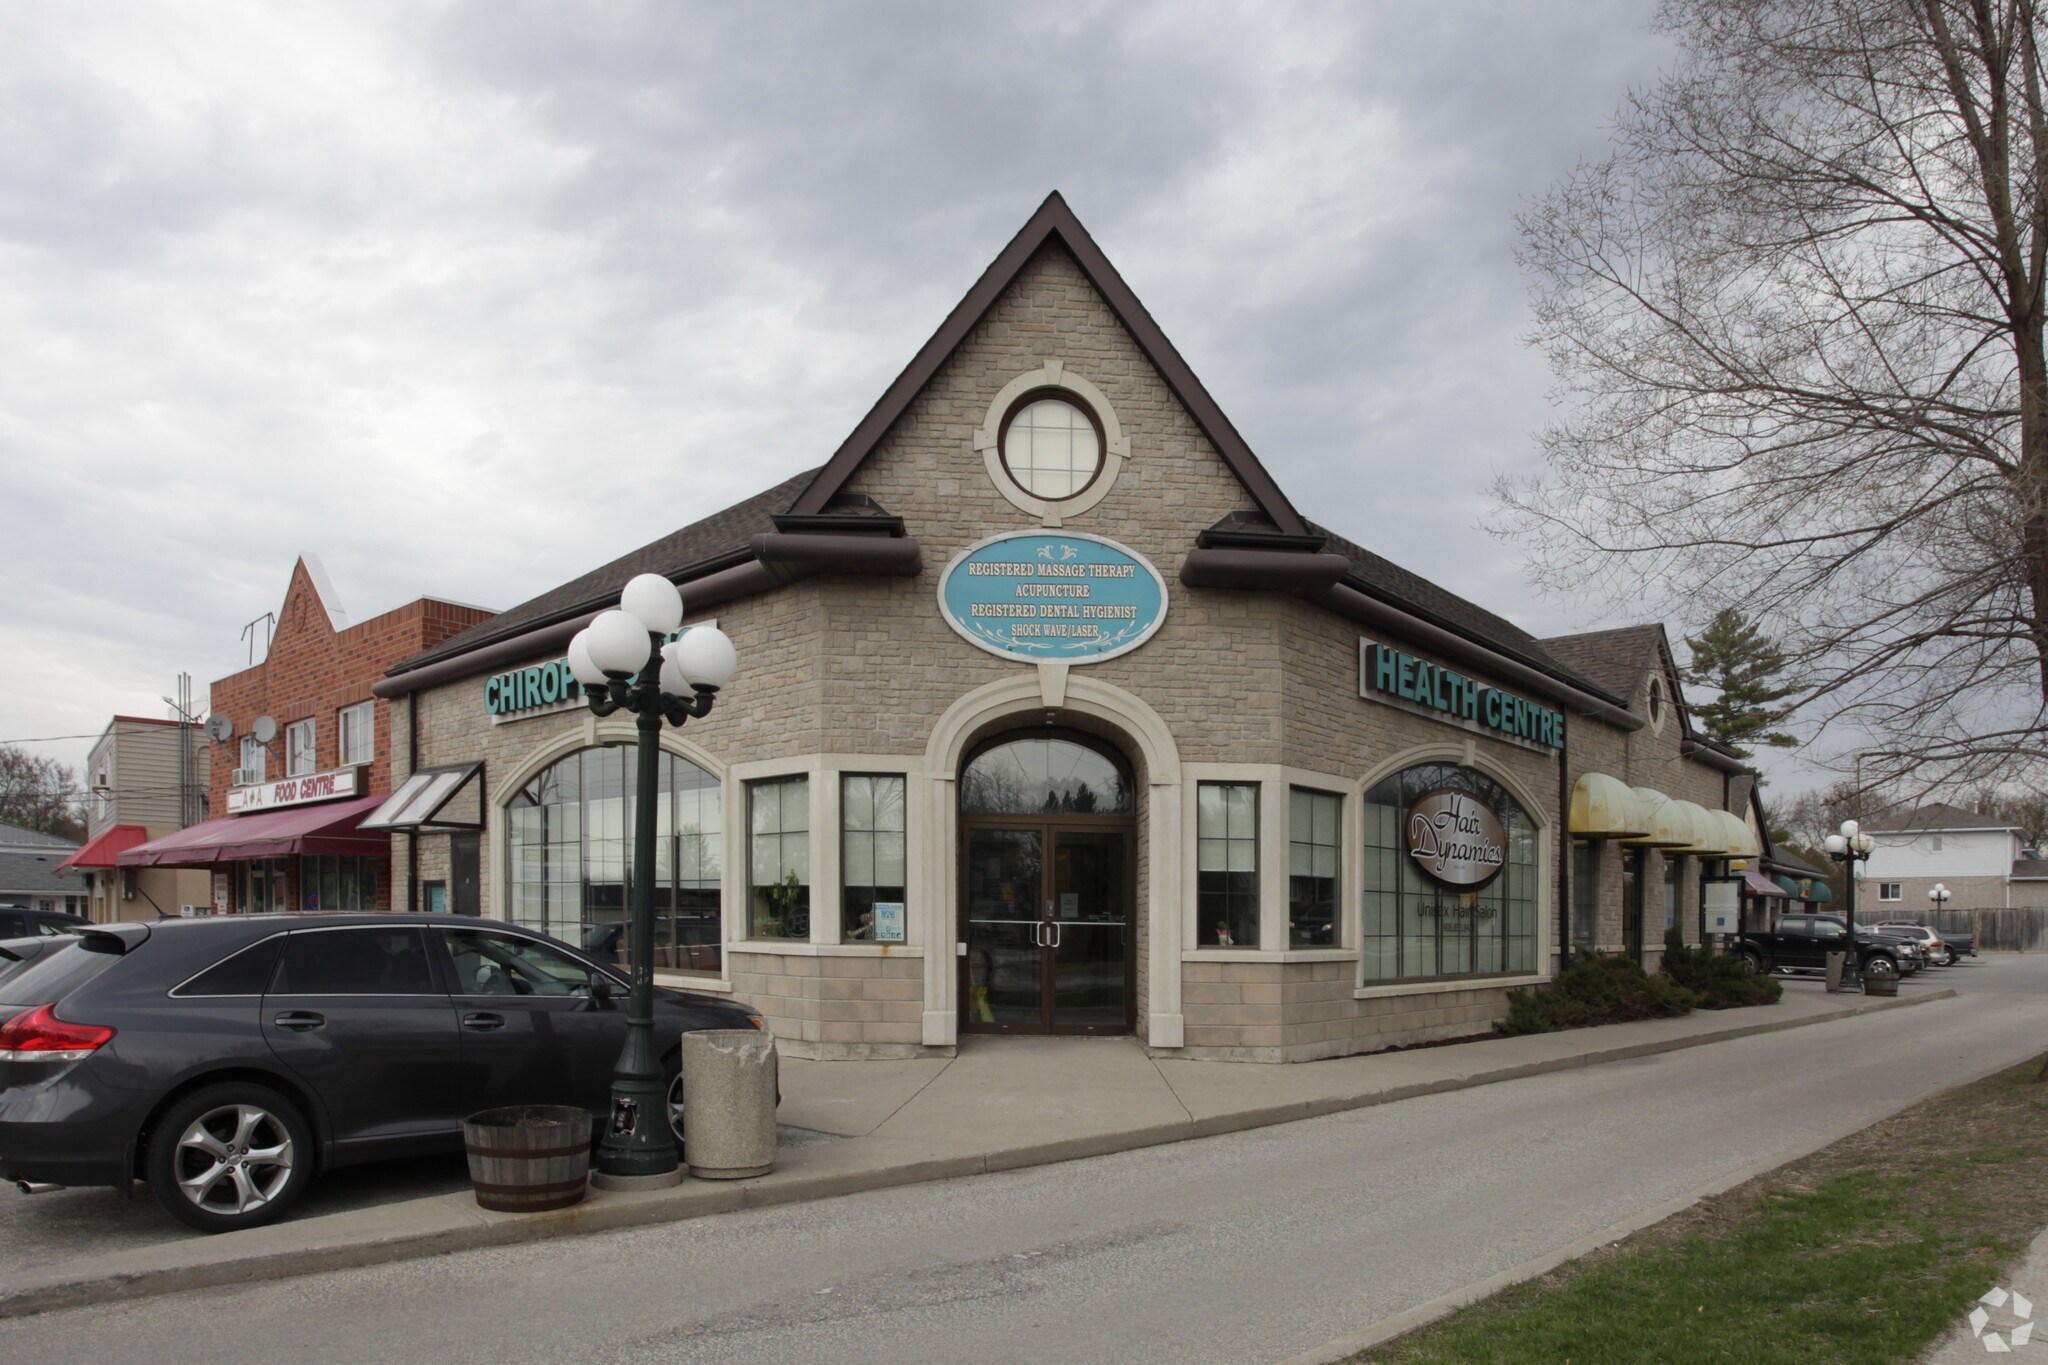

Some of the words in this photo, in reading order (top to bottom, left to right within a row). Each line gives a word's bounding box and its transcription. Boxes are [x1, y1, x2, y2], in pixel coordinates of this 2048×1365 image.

[968, 562, 1035, 577] REGISTERED
[1037, 563, 1086, 578] MASSAGE
[1088, 564, 1136, 579] THERAPY
[1015, 584, 1090, 598] ACUPUNCTURE
[971, 603, 1037, 618] REGISTERED
[1039, 604, 1080, 618] DENTAL
[1082, 605, 1138, 619] HYGIENIST
[1011, 623, 1041, 637] SHOCK
[1043, 624, 1100, 639] WAVE/LASER
[1375, 643, 1479, 721] HEALTH
[1485, 687, 1564, 749] CENTRE
[273, 782, 297, 803] FOOD
[300, 774, 336, 799] CENTRE
[1433, 792, 1482, 835] Hair
[1411, 813, 1503, 873] Dynamics
